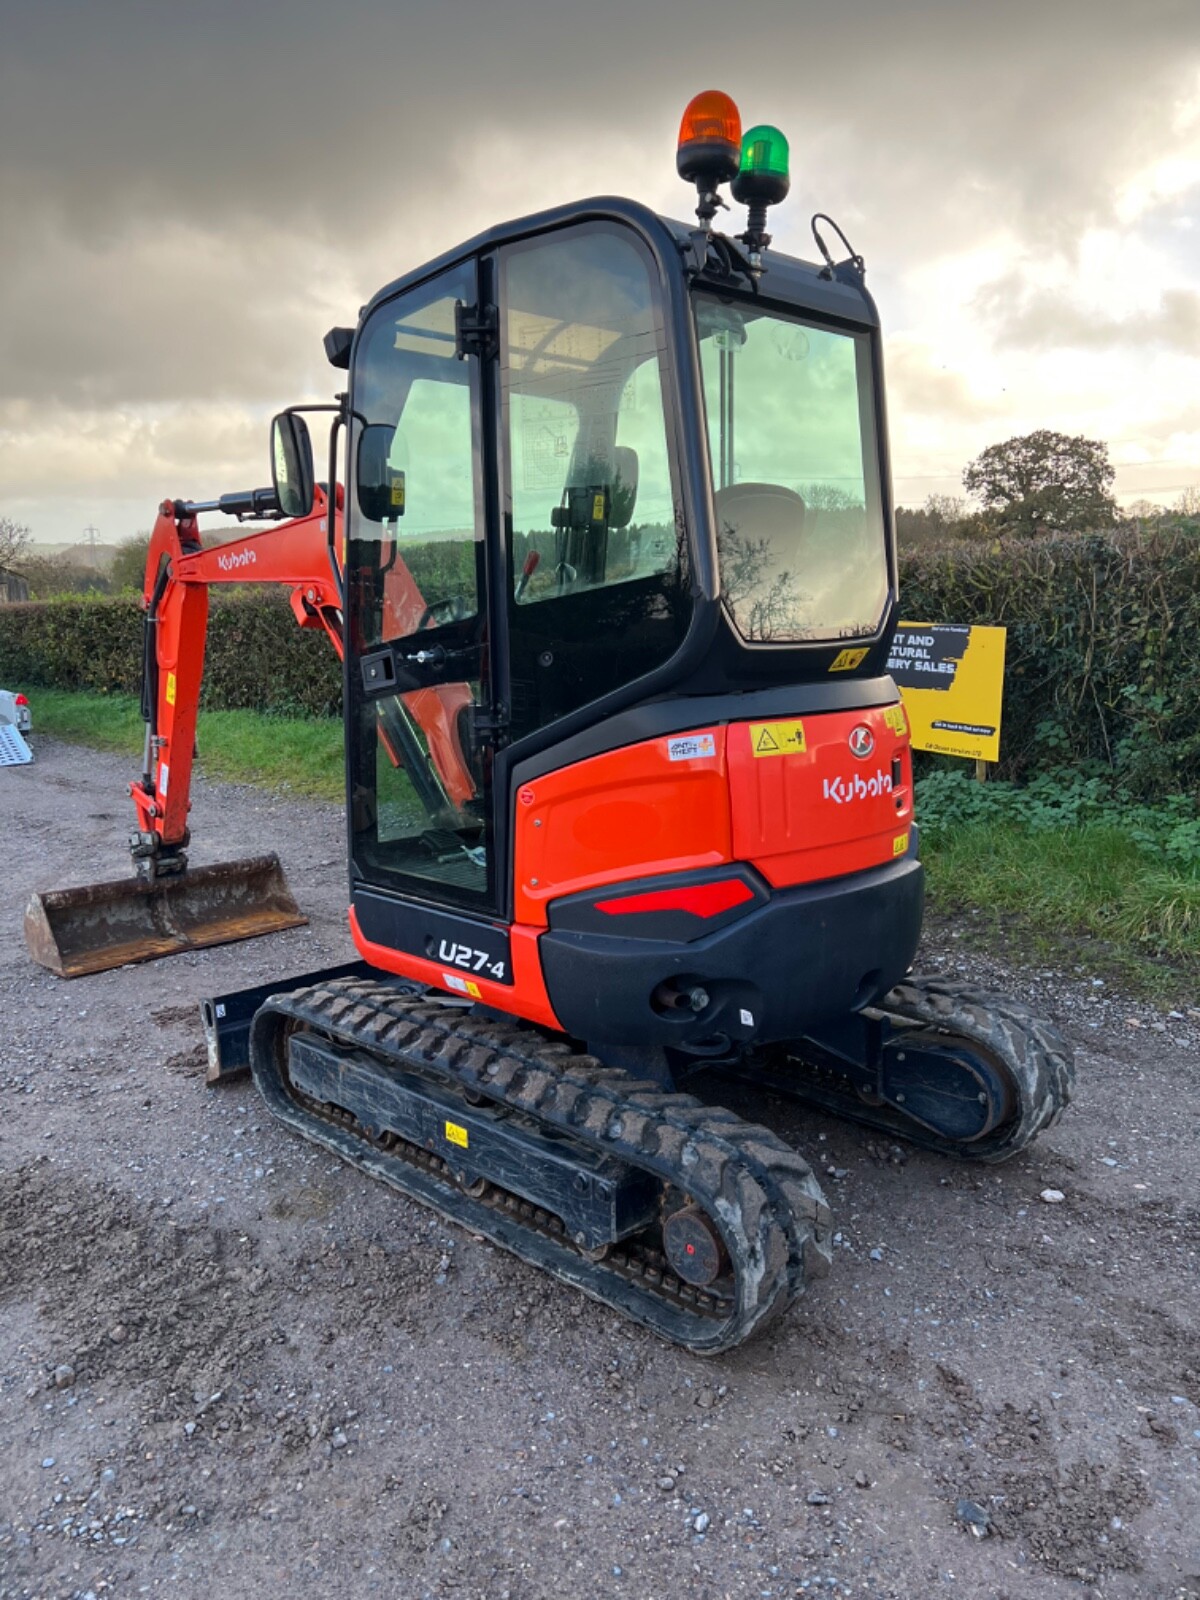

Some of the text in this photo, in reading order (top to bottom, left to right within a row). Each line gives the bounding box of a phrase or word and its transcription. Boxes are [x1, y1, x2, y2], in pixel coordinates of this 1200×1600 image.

[217, 547, 257, 571] Kubota
[907, 635, 935, 647] AND
[889, 646, 931, 659] TURAL
[886, 658, 955, 674] ERY SALES
[823, 769, 893, 804] Kubota
[439, 939, 505, 978] U27-4
